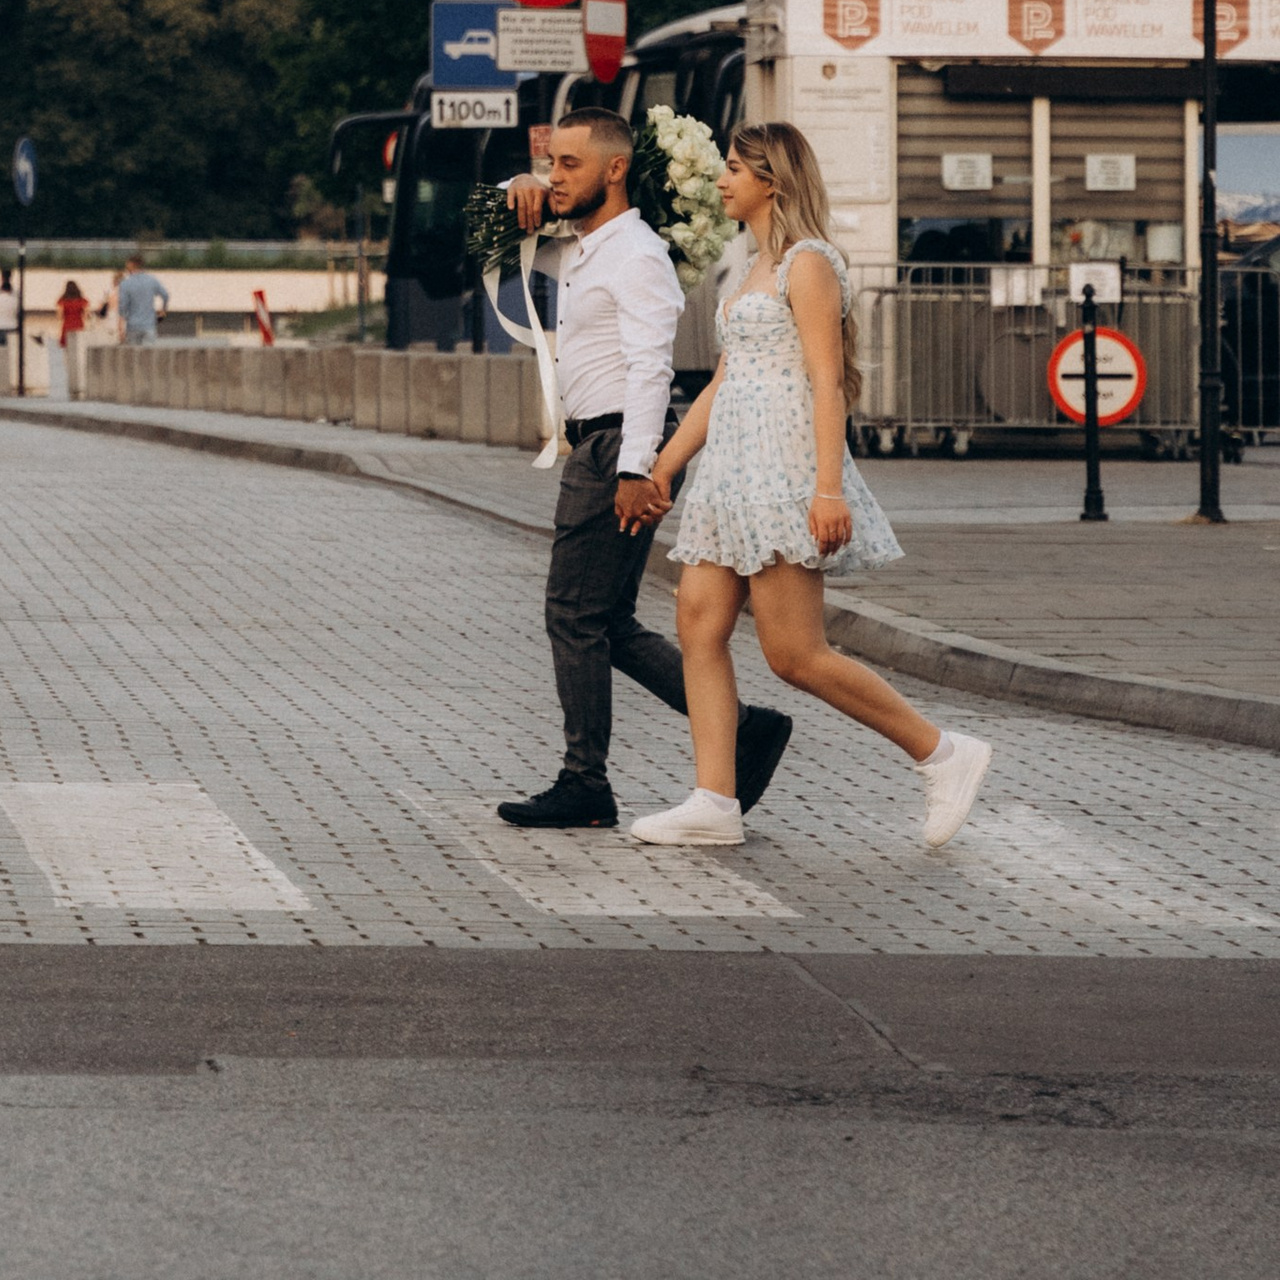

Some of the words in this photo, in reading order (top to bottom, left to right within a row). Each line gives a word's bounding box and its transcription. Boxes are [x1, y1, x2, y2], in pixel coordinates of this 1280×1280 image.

[900, 5, 933, 19] POD
[901, 20, 980, 36] WAWELEM
[1085, 22, 1164, 39] WAWELEM
